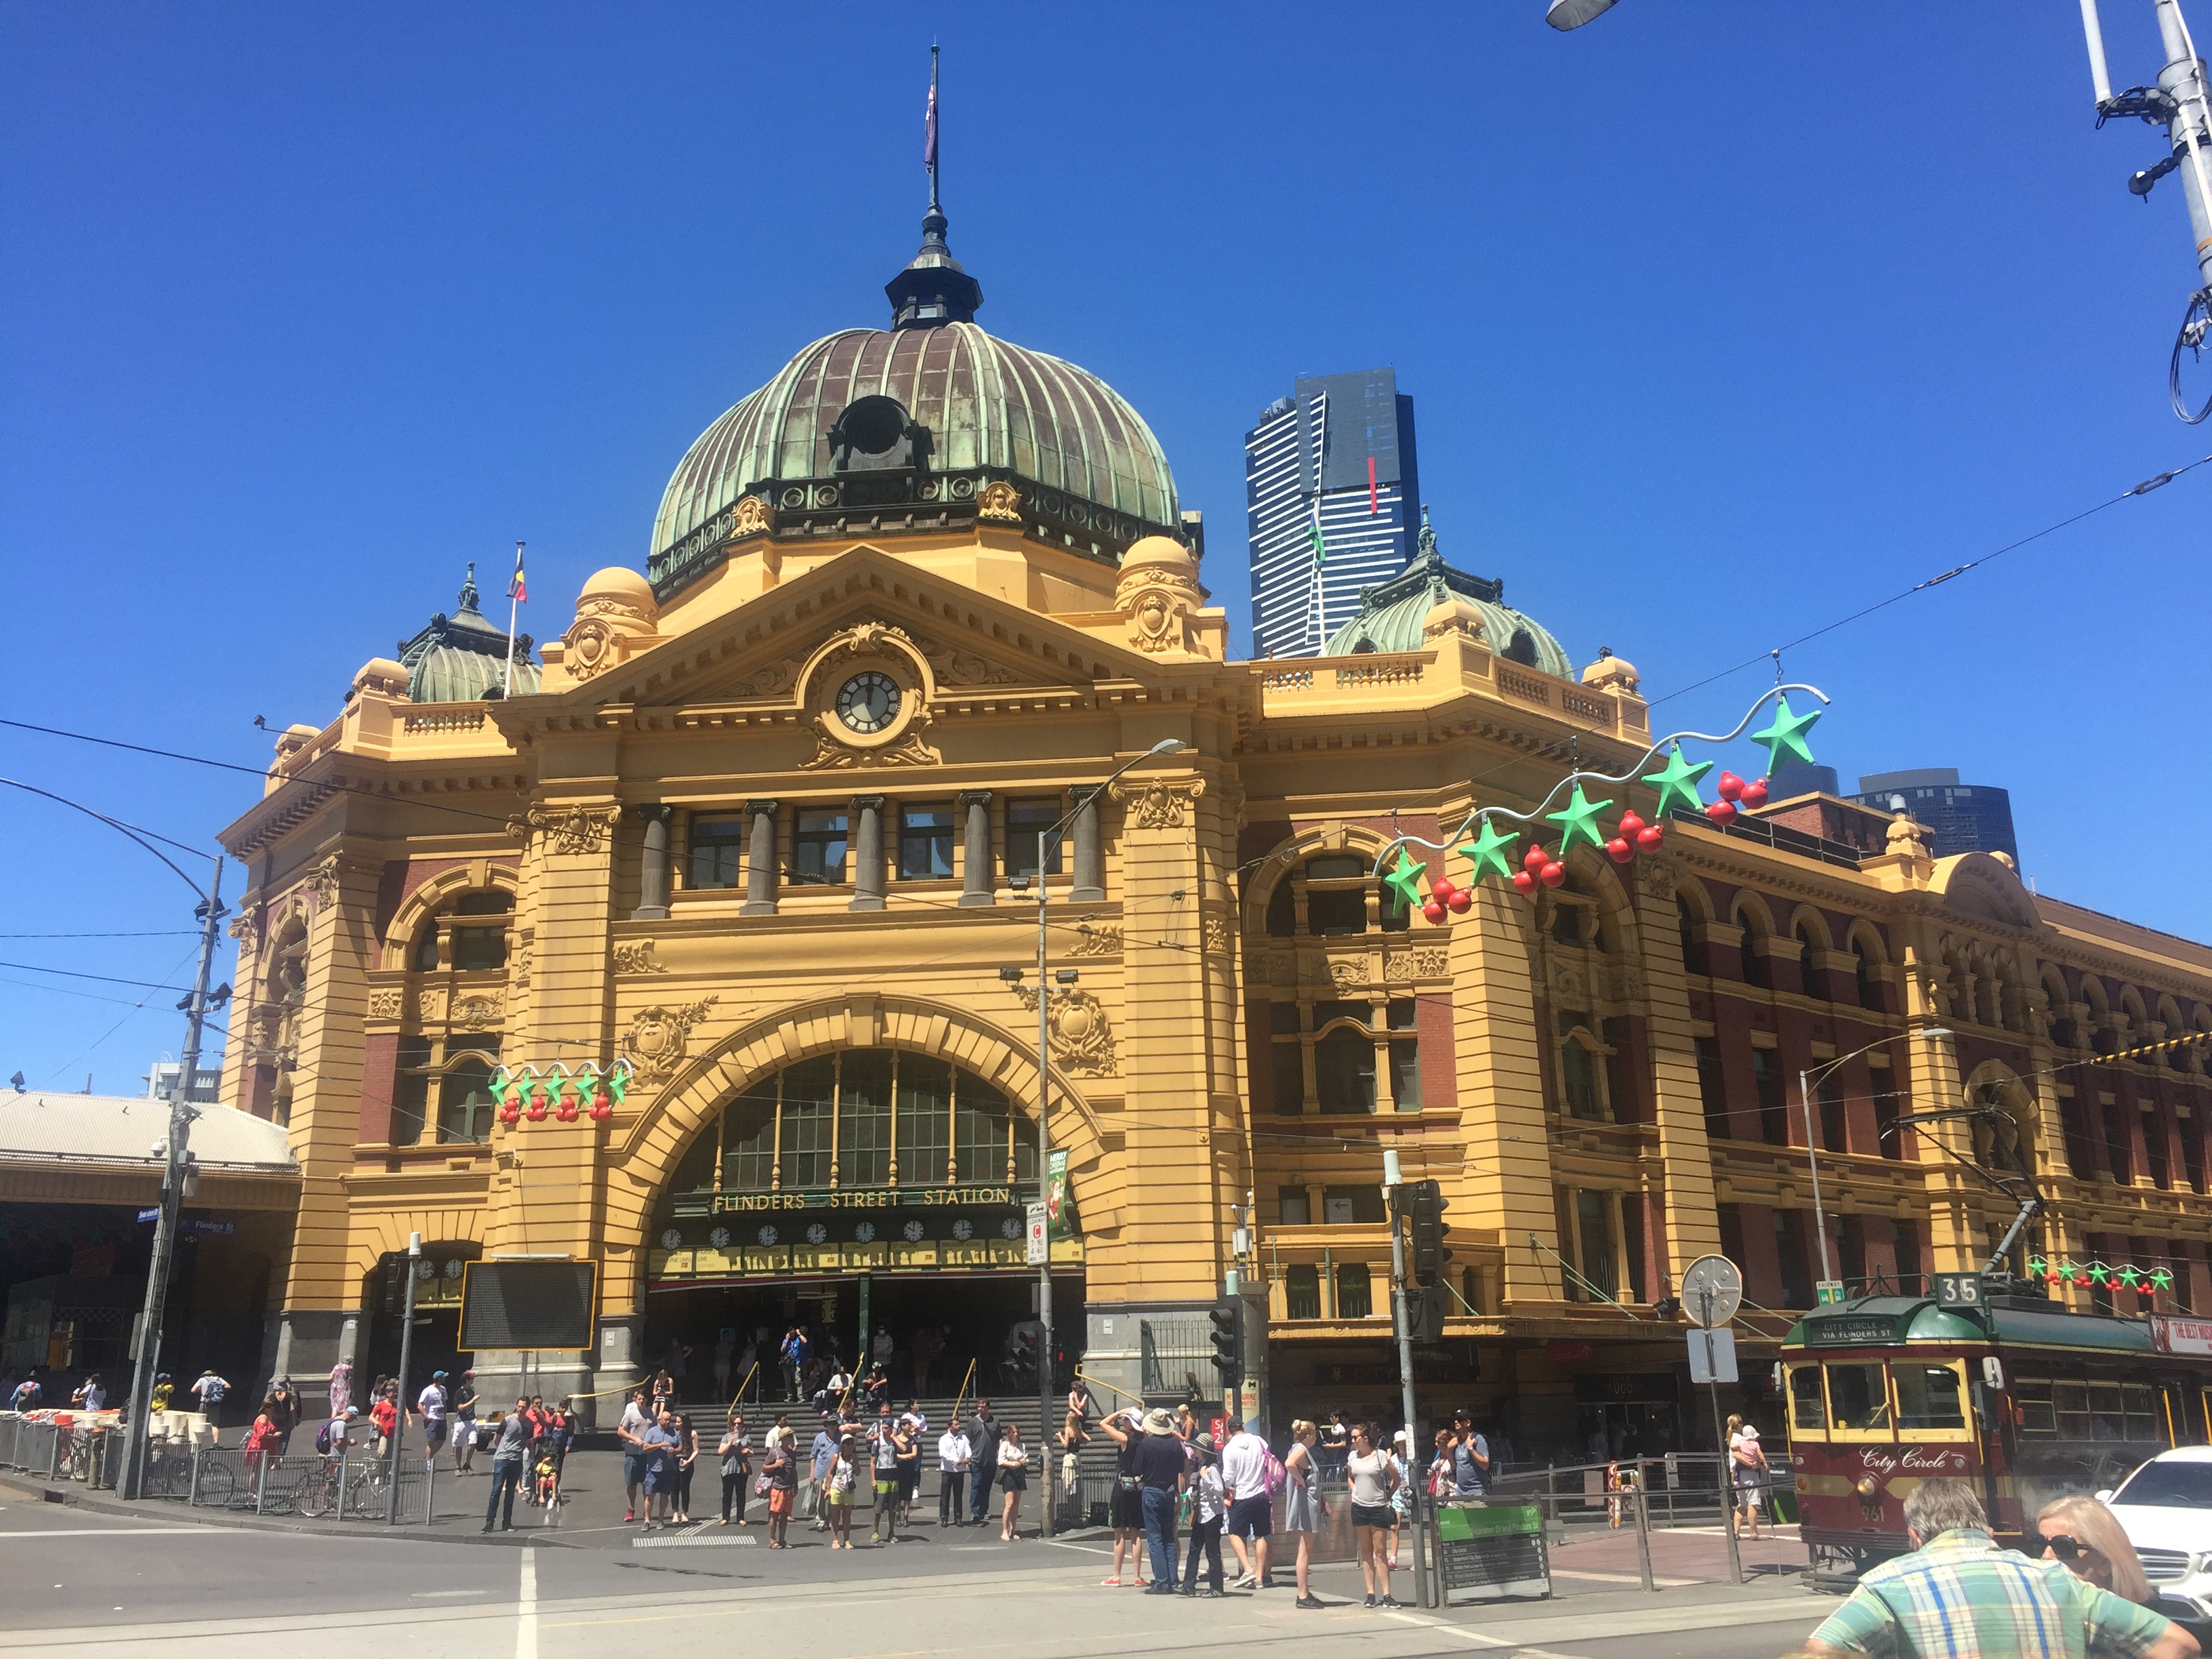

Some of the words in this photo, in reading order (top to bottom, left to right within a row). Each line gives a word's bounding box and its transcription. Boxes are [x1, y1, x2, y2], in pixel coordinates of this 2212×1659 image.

[1050, 1151, 1067, 1162] MERRY
[714, 1193, 805, 1212] FLINDERS
[830, 1191, 900, 1208] STREET
[924, 1188, 1010, 1206] STATION
[195, 1221, 224, 1229] Flinders
[1033, 1225, 1040, 1238] C
[1943, 1278, 1976, 1302] 35
[1824, 1323, 1843, 1331] CITY
[1839, 1330, 1877, 1338] FLINDERS
[1859, 1446, 1897, 1474] City
[1898, 1446, 1950, 1468] Circle
[1862, 1506, 1885, 1522] 961
